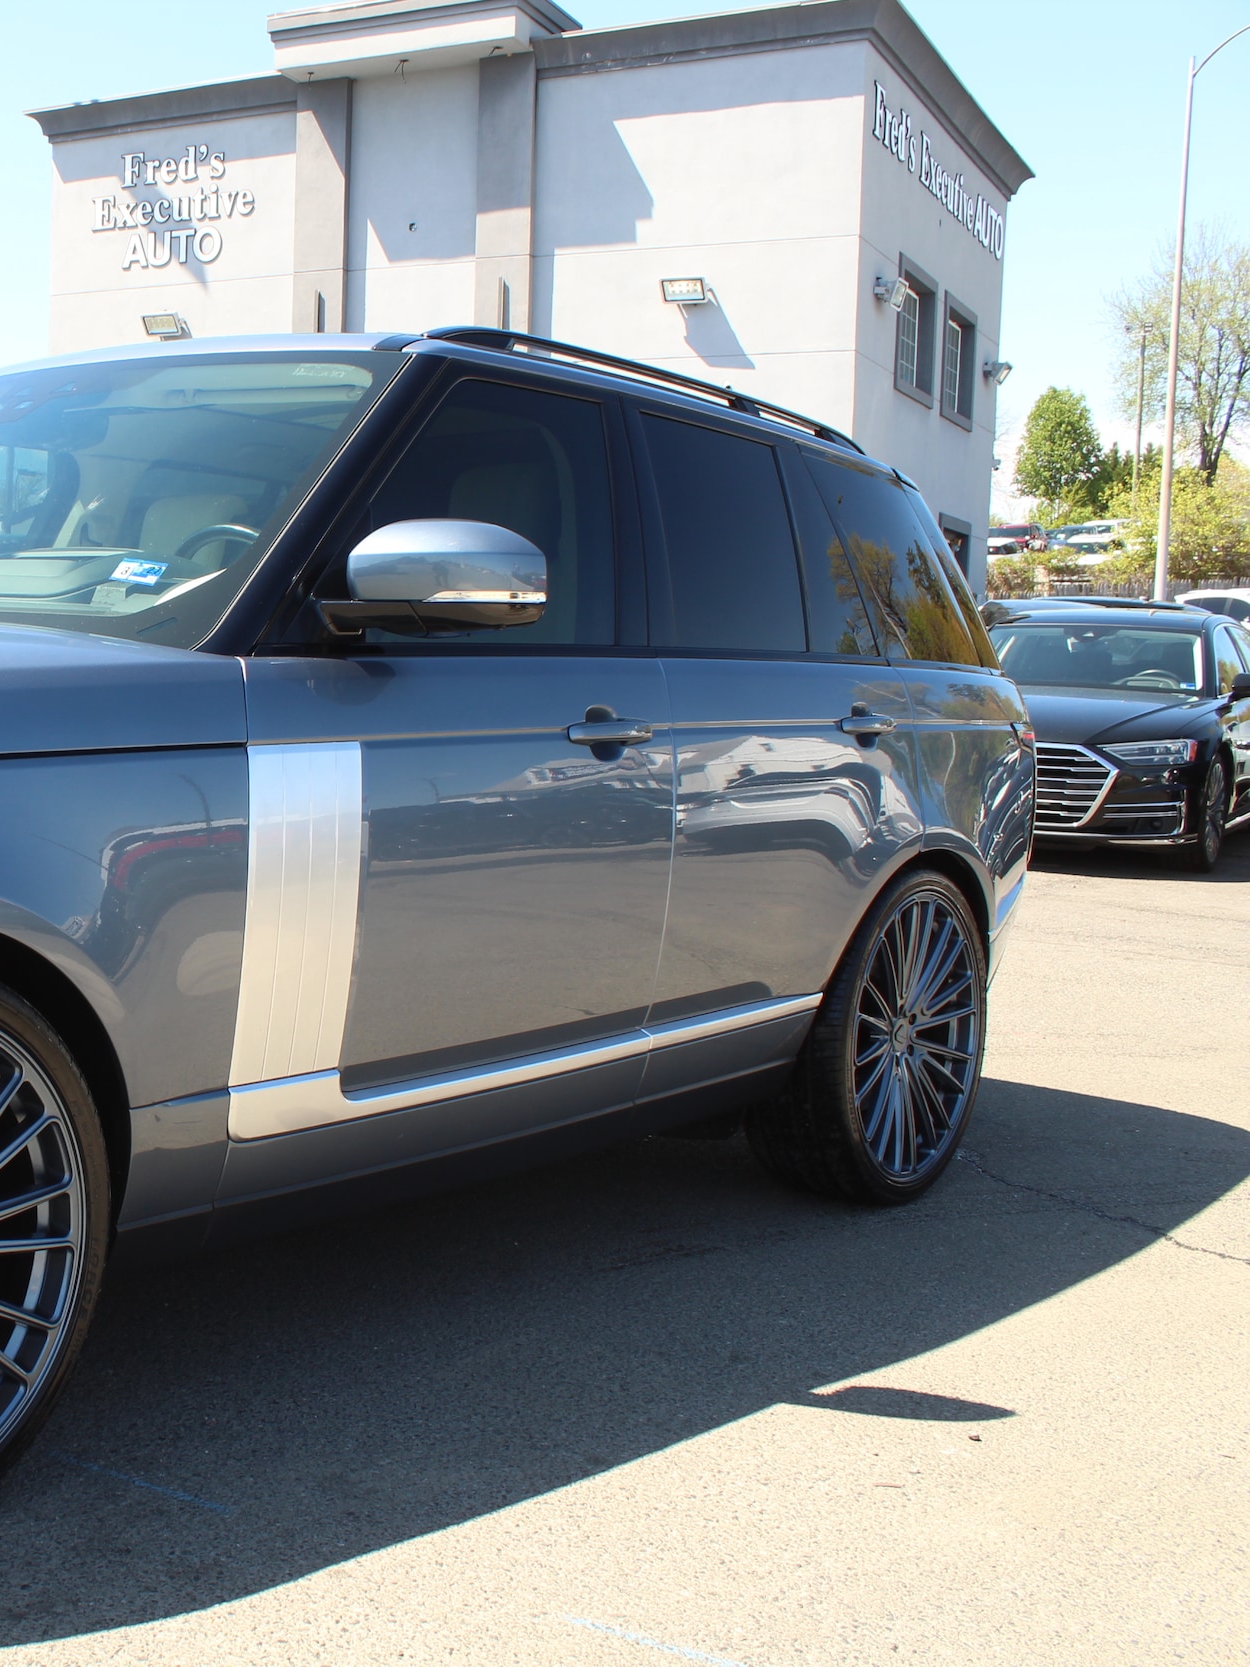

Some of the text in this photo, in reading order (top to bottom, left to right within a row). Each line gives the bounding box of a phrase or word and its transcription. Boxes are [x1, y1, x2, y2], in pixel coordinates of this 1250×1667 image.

[121, 144, 226, 189] Fred's
[872, 80, 1004, 260] Fred's Executive AUTO
[91, 183, 256, 232] Executive
[121, 225, 224, 269] AUTO
